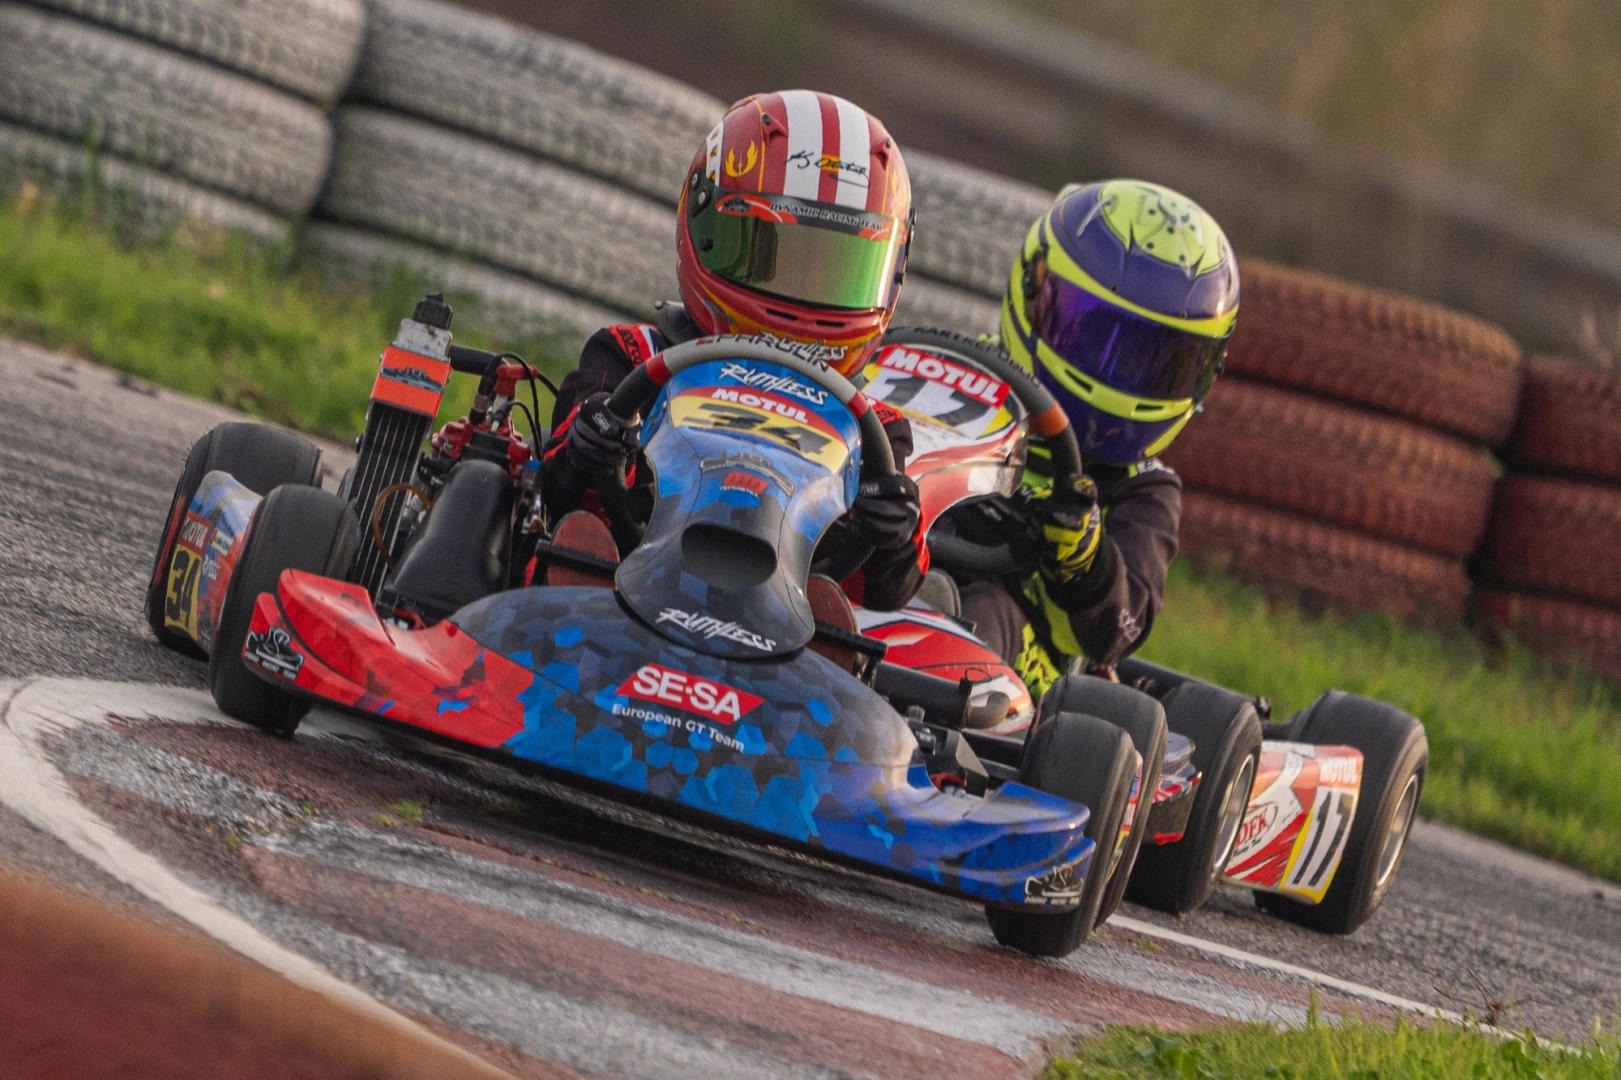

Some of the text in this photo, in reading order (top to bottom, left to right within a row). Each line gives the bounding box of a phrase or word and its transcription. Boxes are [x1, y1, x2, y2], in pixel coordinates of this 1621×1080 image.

[718, 361, 829, 406] RUTHLESS
[884, 348, 1000, 404] MOTUL
[711, 388, 809, 424] MOTUL
[166, 550, 200, 628] 34
[655, 607, 777, 652] RUTHLESS
[611, 703, 745, 753] European GT Team
[1319, 756, 1358, 785] MOTUL
[1292, 790, 1354, 888] 17
